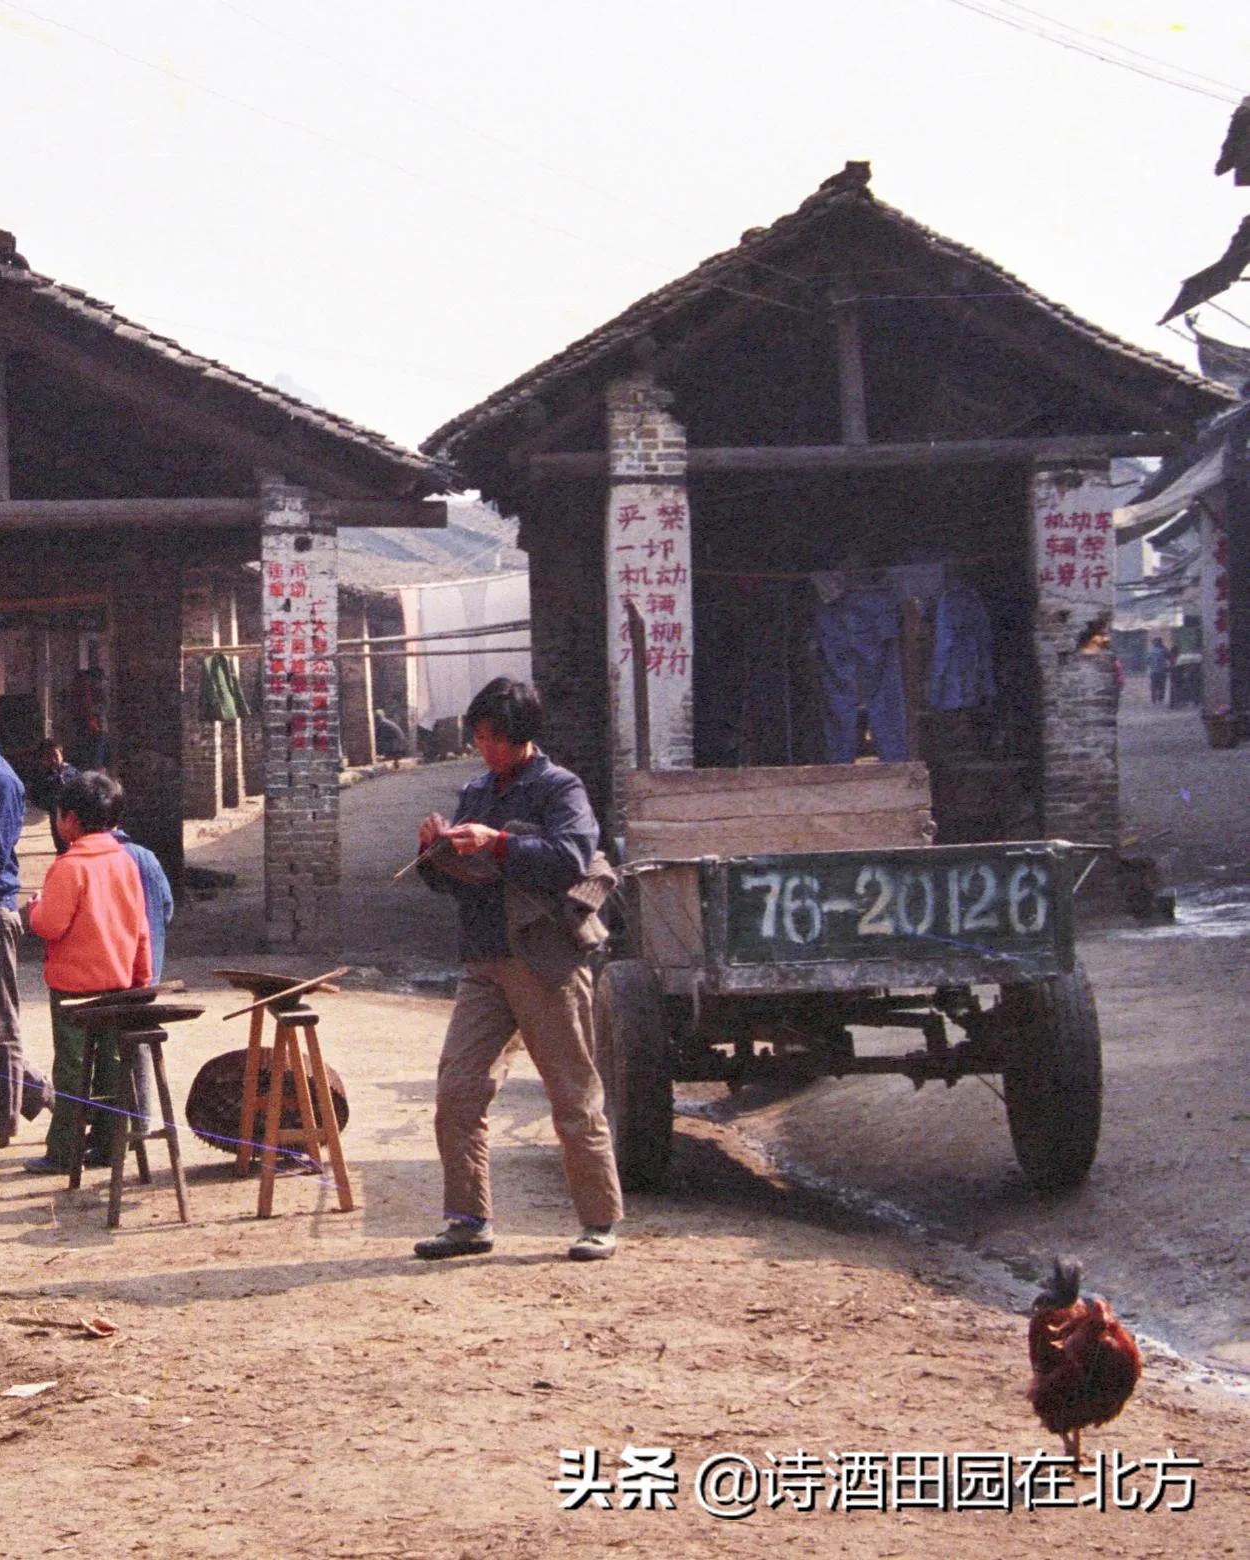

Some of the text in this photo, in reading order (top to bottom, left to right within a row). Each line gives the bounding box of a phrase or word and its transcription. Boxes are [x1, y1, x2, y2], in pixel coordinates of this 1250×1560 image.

[617, 504, 686, 531] 严禁
[1044, 511, 1112, 533] 机动车
[616, 539, 675, 561] 一切
[618, 563, 687, 586] 机动
[1040, 562, 1109, 590] 止穿行
[742, 863, 1047, 944] 76-20126
